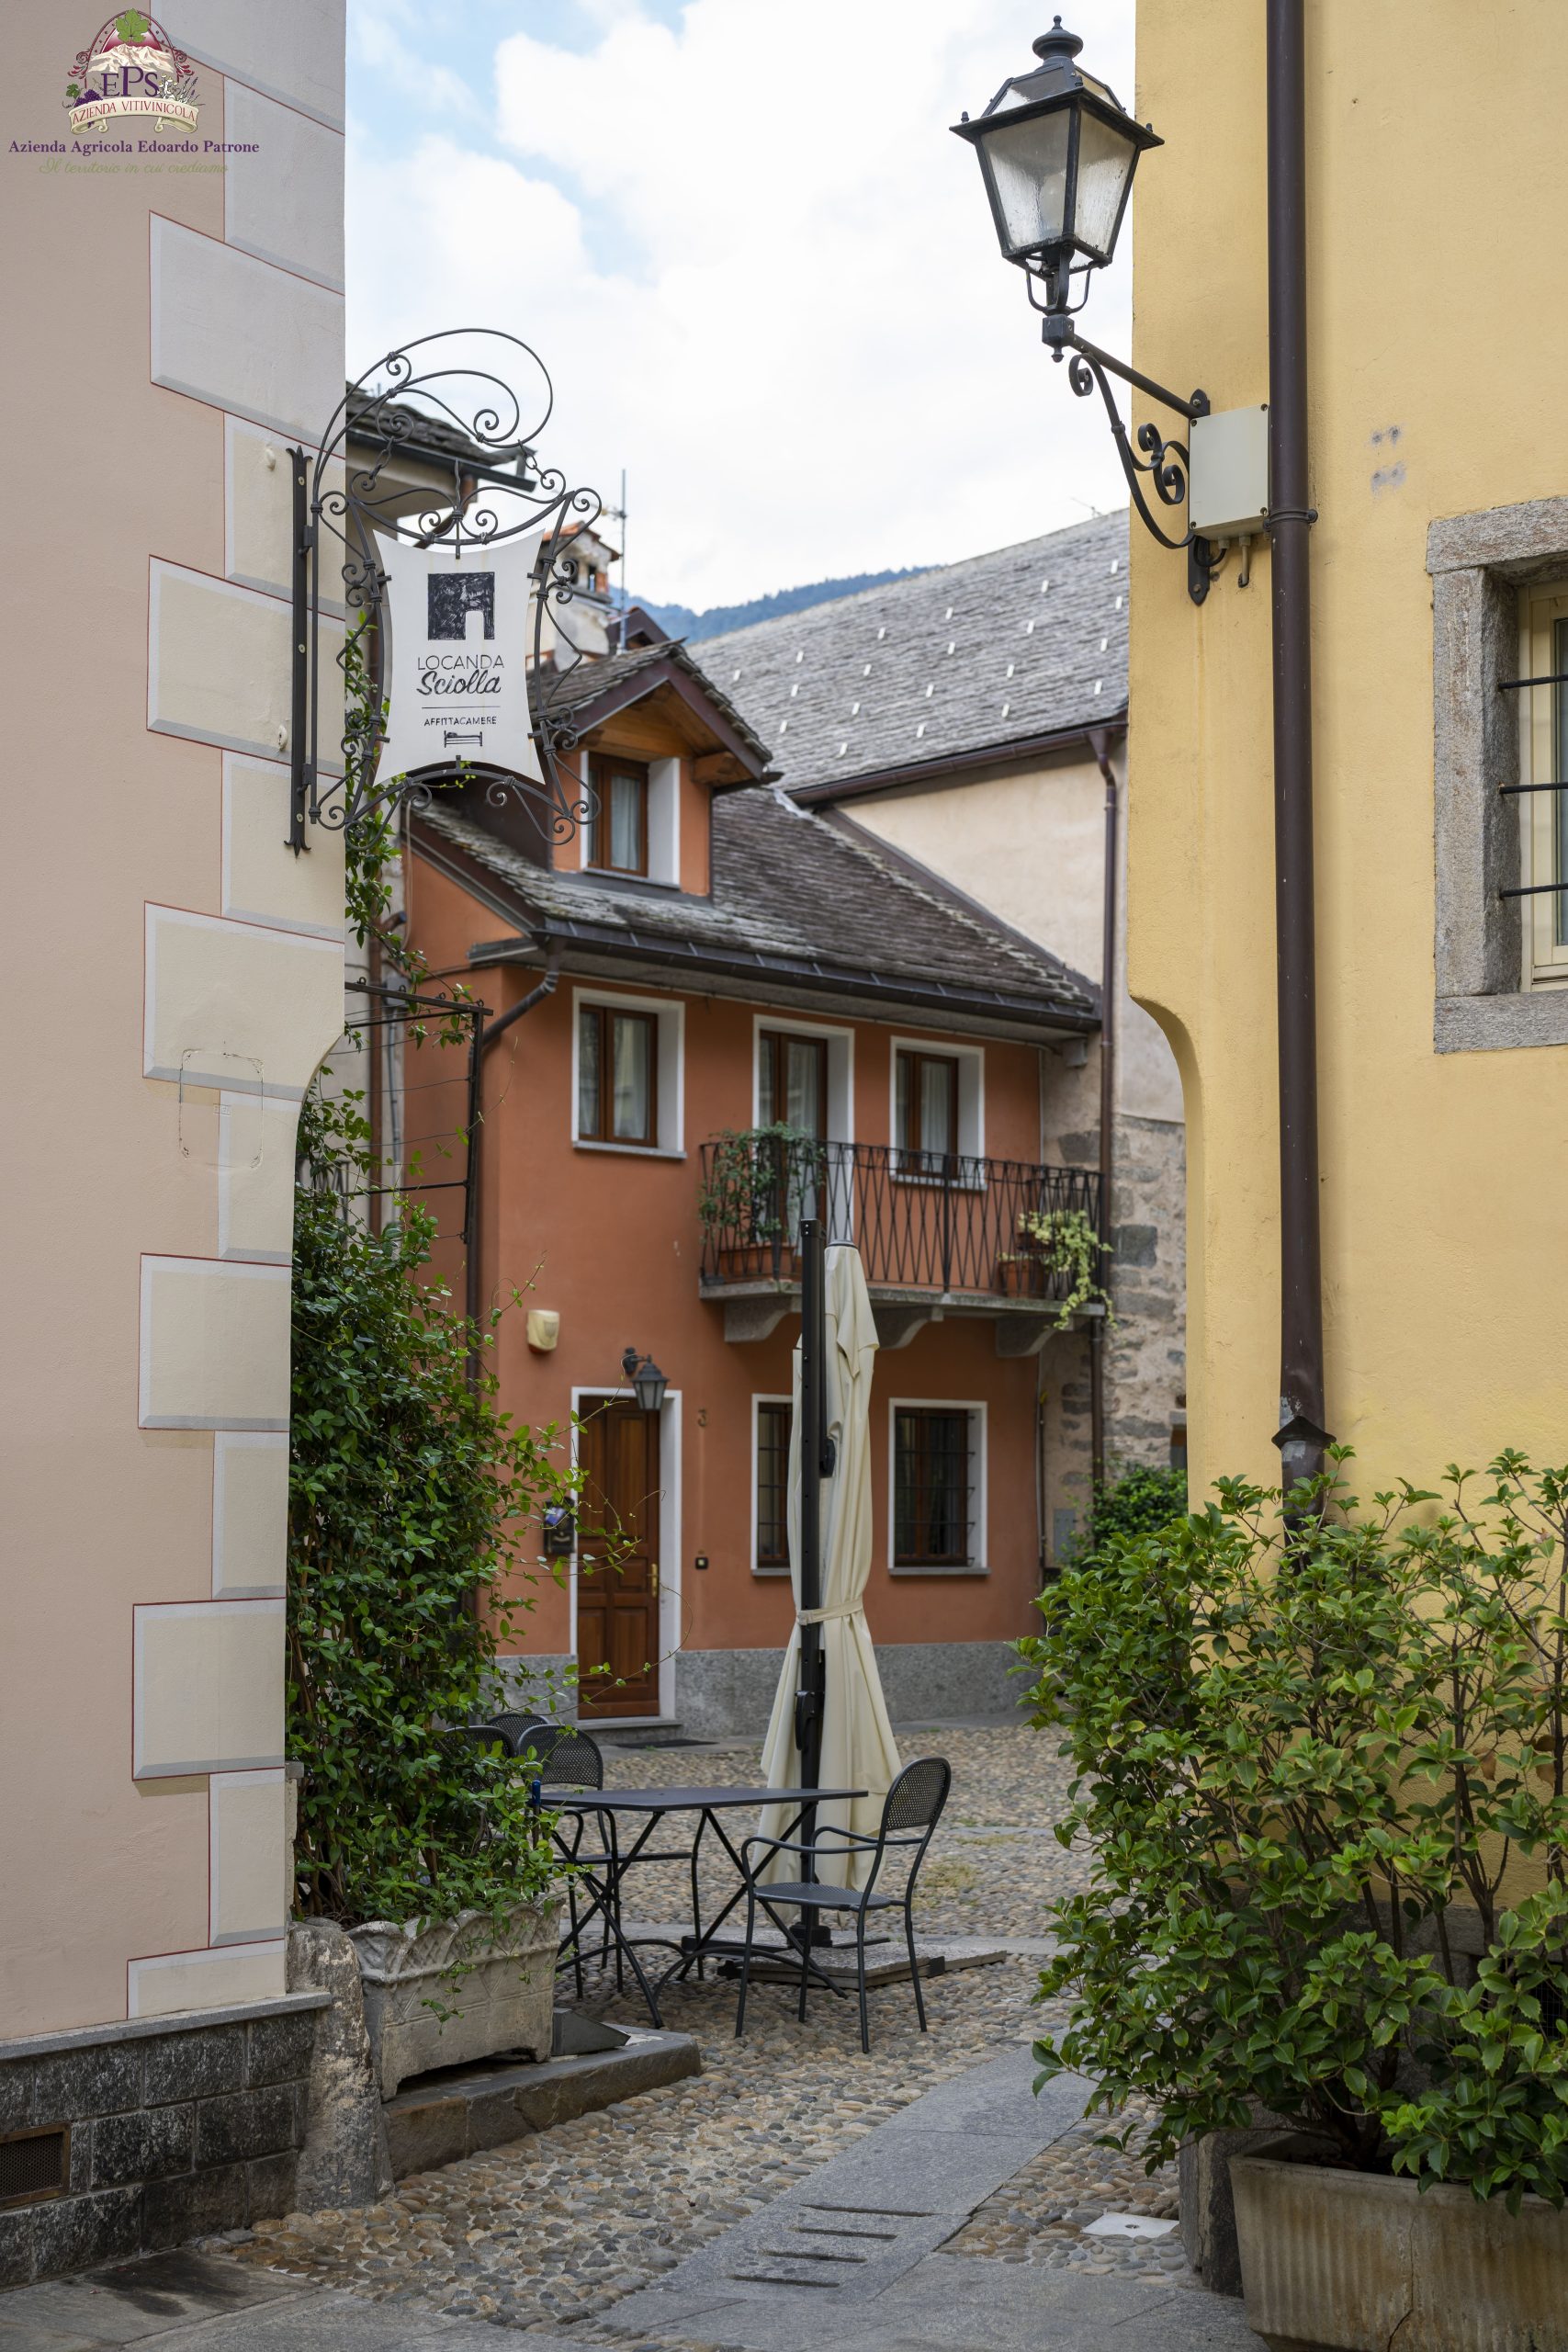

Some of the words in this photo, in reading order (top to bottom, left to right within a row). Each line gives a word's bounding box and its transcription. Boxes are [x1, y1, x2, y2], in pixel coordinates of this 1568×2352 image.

[417, 654, 504, 671] LOCANDA
[416, 670, 502, 696] Sciolla
[423, 716, 497, 727] AFFITTACAMERE
[696, 1408, 707, 1428] 3
